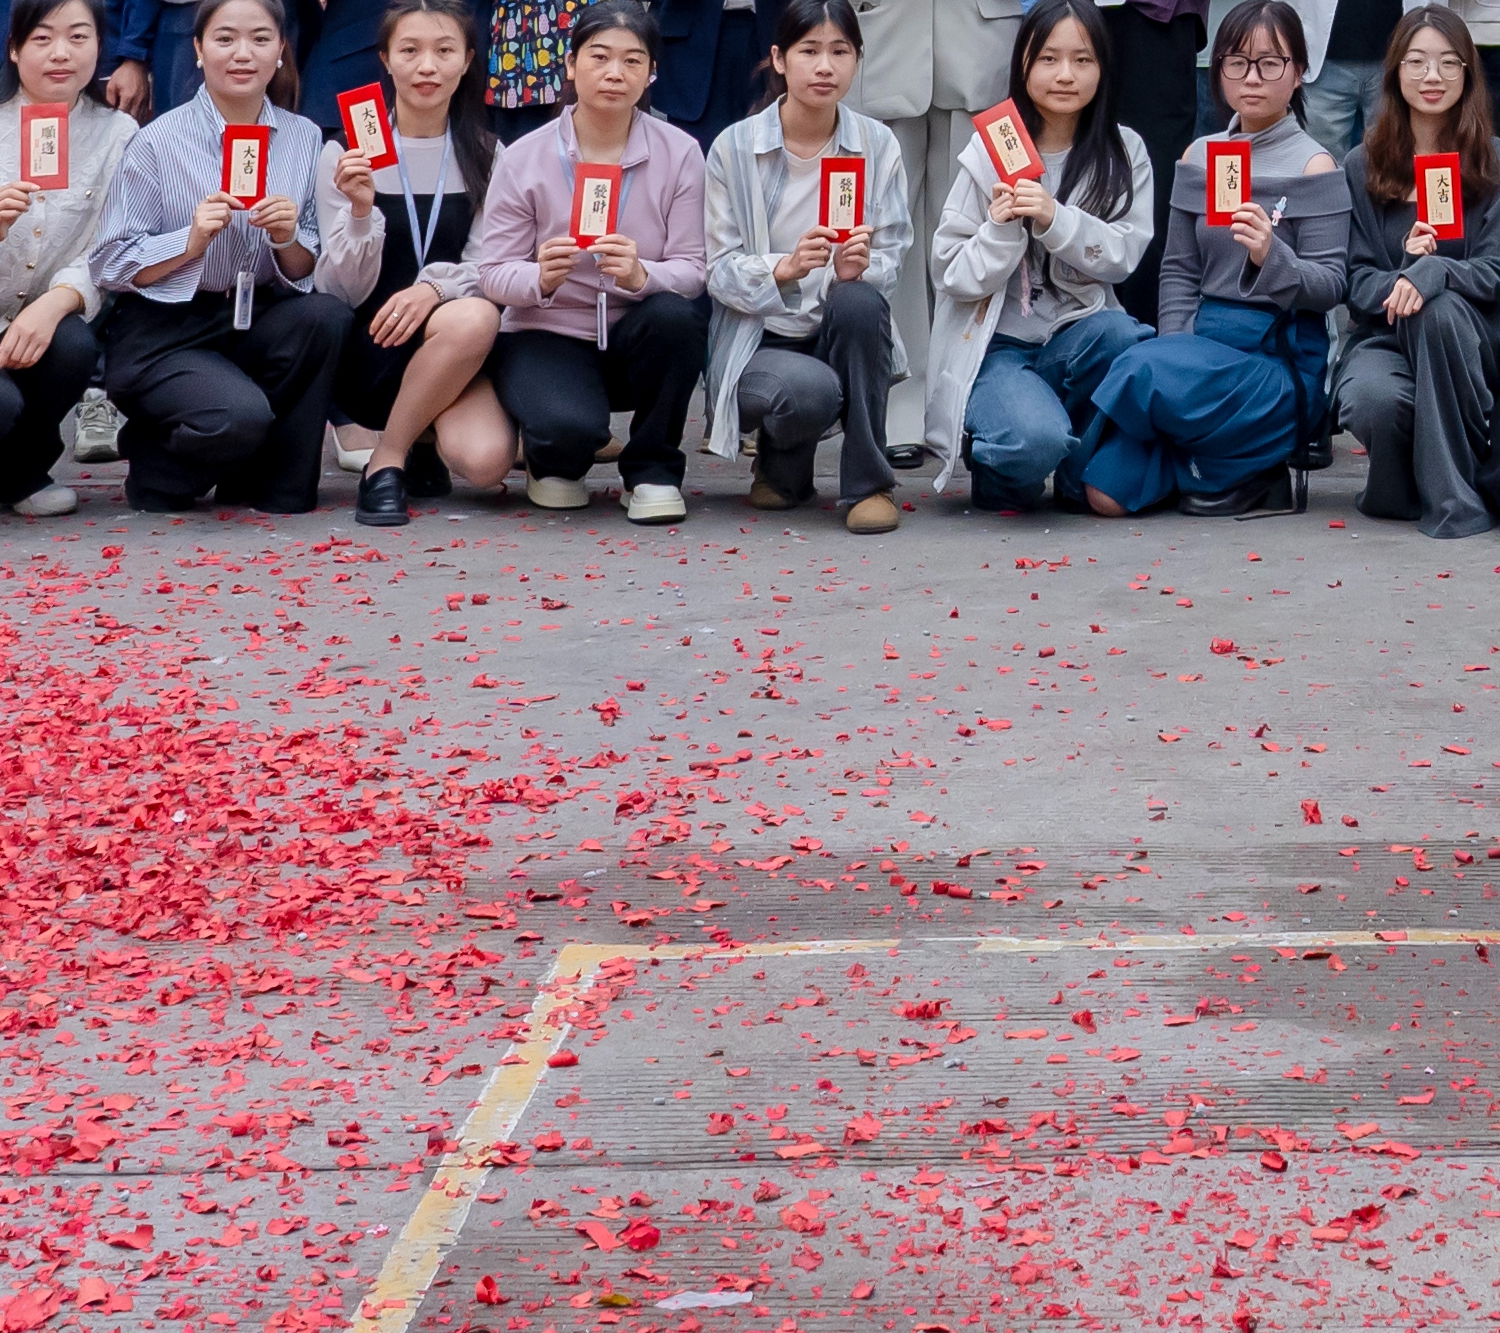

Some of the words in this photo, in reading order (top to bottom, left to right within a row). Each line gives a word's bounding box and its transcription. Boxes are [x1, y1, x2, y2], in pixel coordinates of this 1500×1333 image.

[361, 107, 377, 135] 大吉
[998, 122, 1018, 151] 發財
[242, 145, 257, 175] 大吉
[1226, 160, 1239, 190] 大吉
[593, 183, 607, 214] 發財
[839, 177, 853, 208] 發財
[1436, 174, 1449, 204] 大吉
